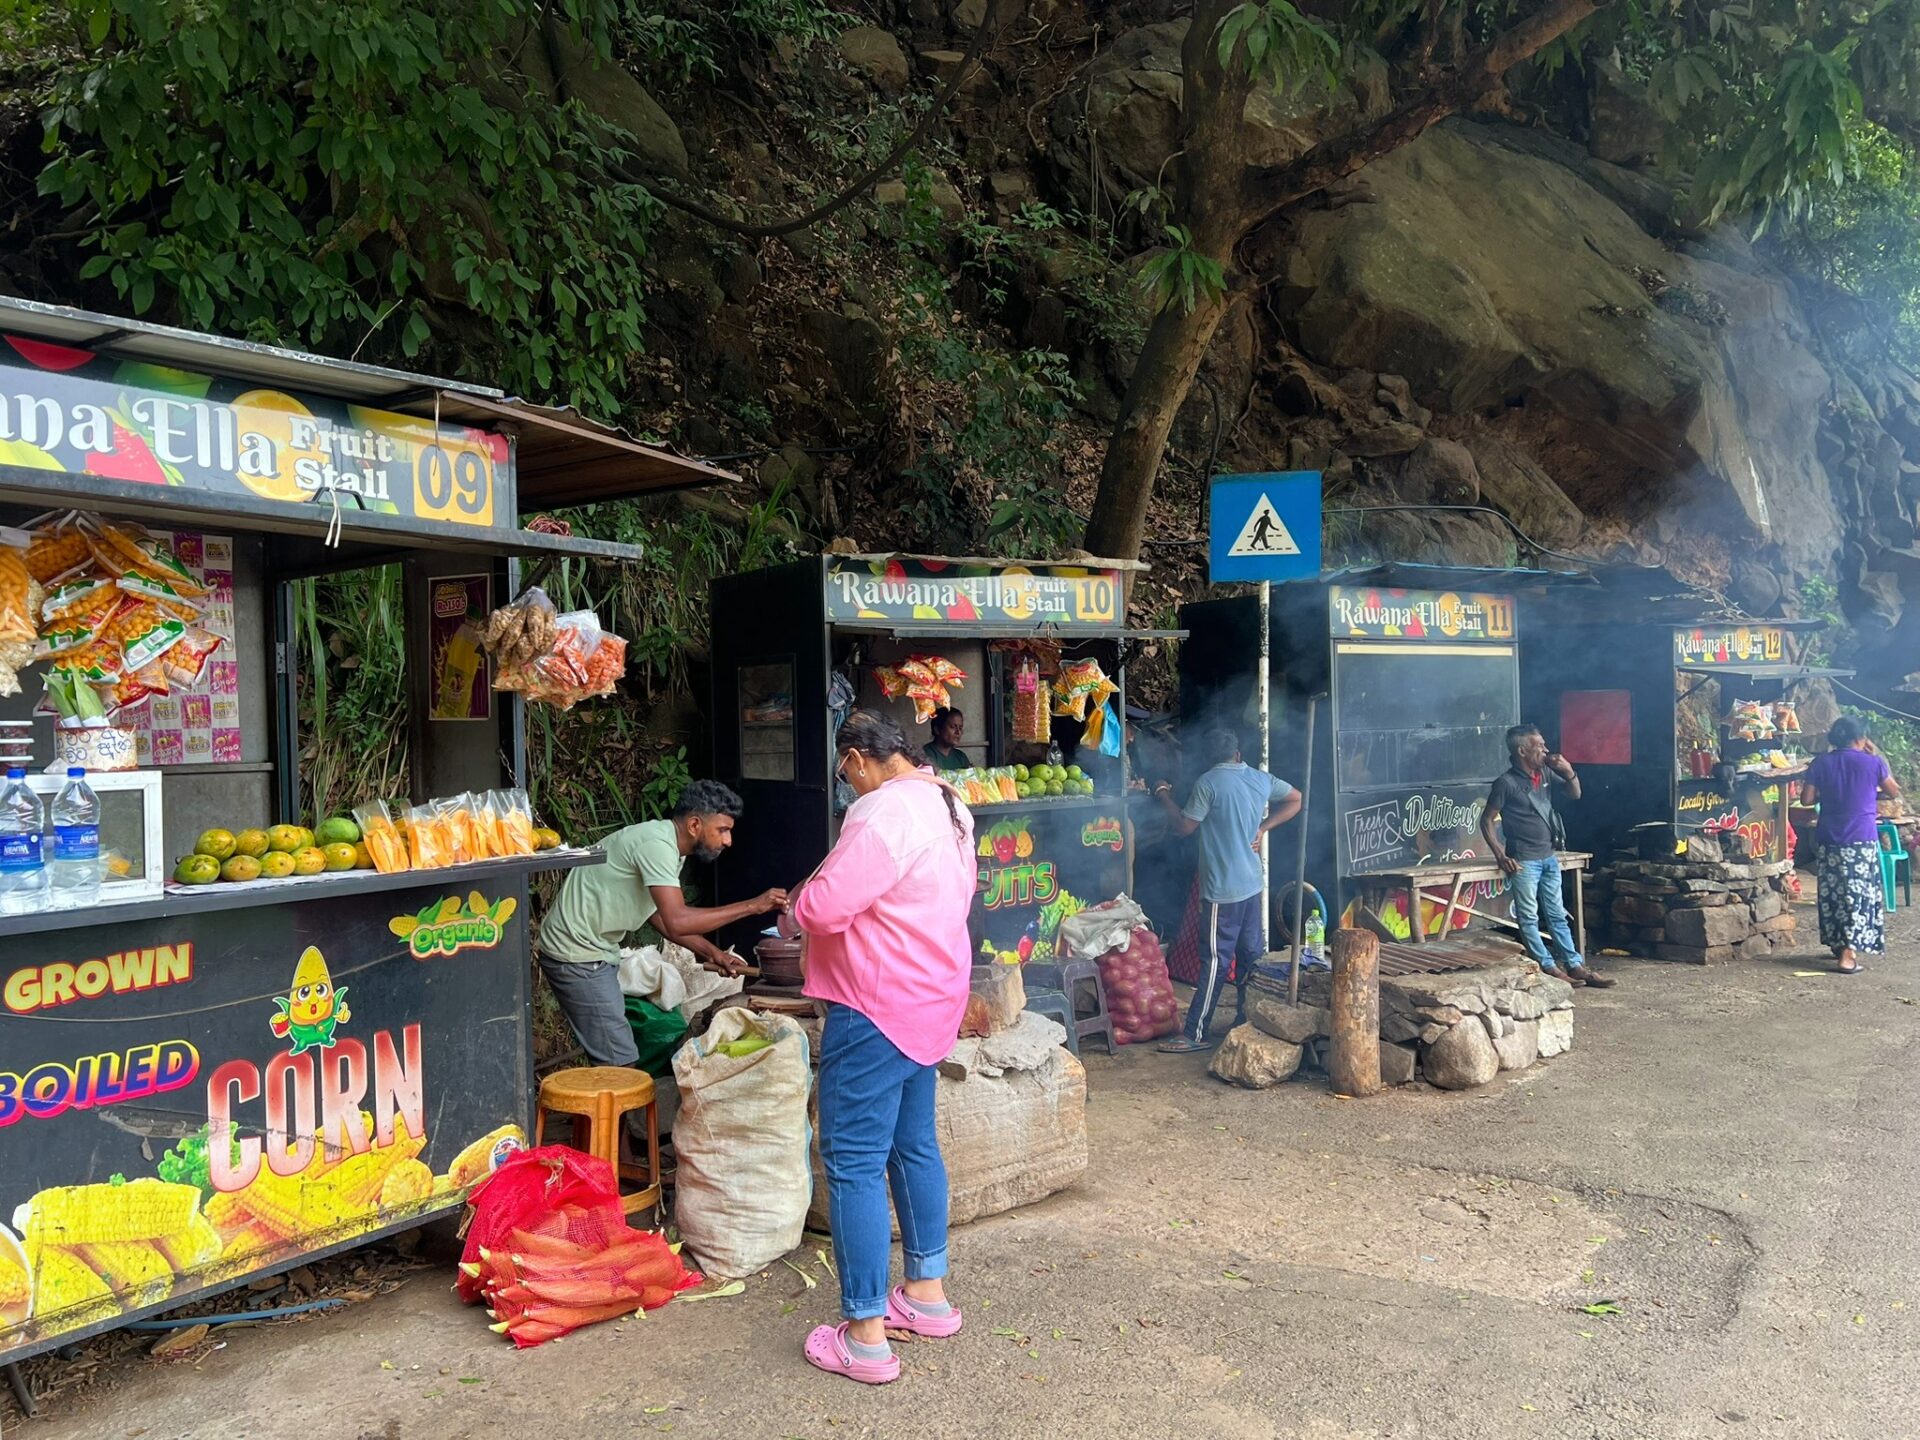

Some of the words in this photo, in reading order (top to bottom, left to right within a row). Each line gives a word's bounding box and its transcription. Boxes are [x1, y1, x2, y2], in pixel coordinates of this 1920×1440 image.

[132, 398, 278, 477] Ella
[289, 416, 392, 464] Fruit
[294, 457, 389, 500] Stall
[418, 444, 488, 514] 09
[834, 571, 957, 610] Rawana
[963, 576, 1018, 609] Ella
[1023, 577, 1067, 594] Fruit
[1082, 580, 1111, 614] 10
[1025, 596, 1066, 613] Stall
[1335, 598, 1412, 629] Rawana
[1415, 602, 1451, 627] Ella
[1453, 601, 1482, 615] Fruit
[1491, 605, 1509, 631] 11
[1455, 617, 1482, 631] Stall
[1676, 633, 1720, 657] Rawana
[1722, 632, 1744, 653] Ella
[1767, 632, 1779, 654] 12
[214, 744, 240, 758] ZINGO
[1678, 791, 1705, 812] Locally
[1083, 828, 1121, 845] Organic
[1352, 807, 1384, 836] Fresh
[1383, 811, 1405, 845] &
[412, 916, 497, 955] Organic
[4, 942, 193, 1014] GROWN
[0, 1040, 200, 1126] BOILED
[207, 1022, 424, 1193] CORN
